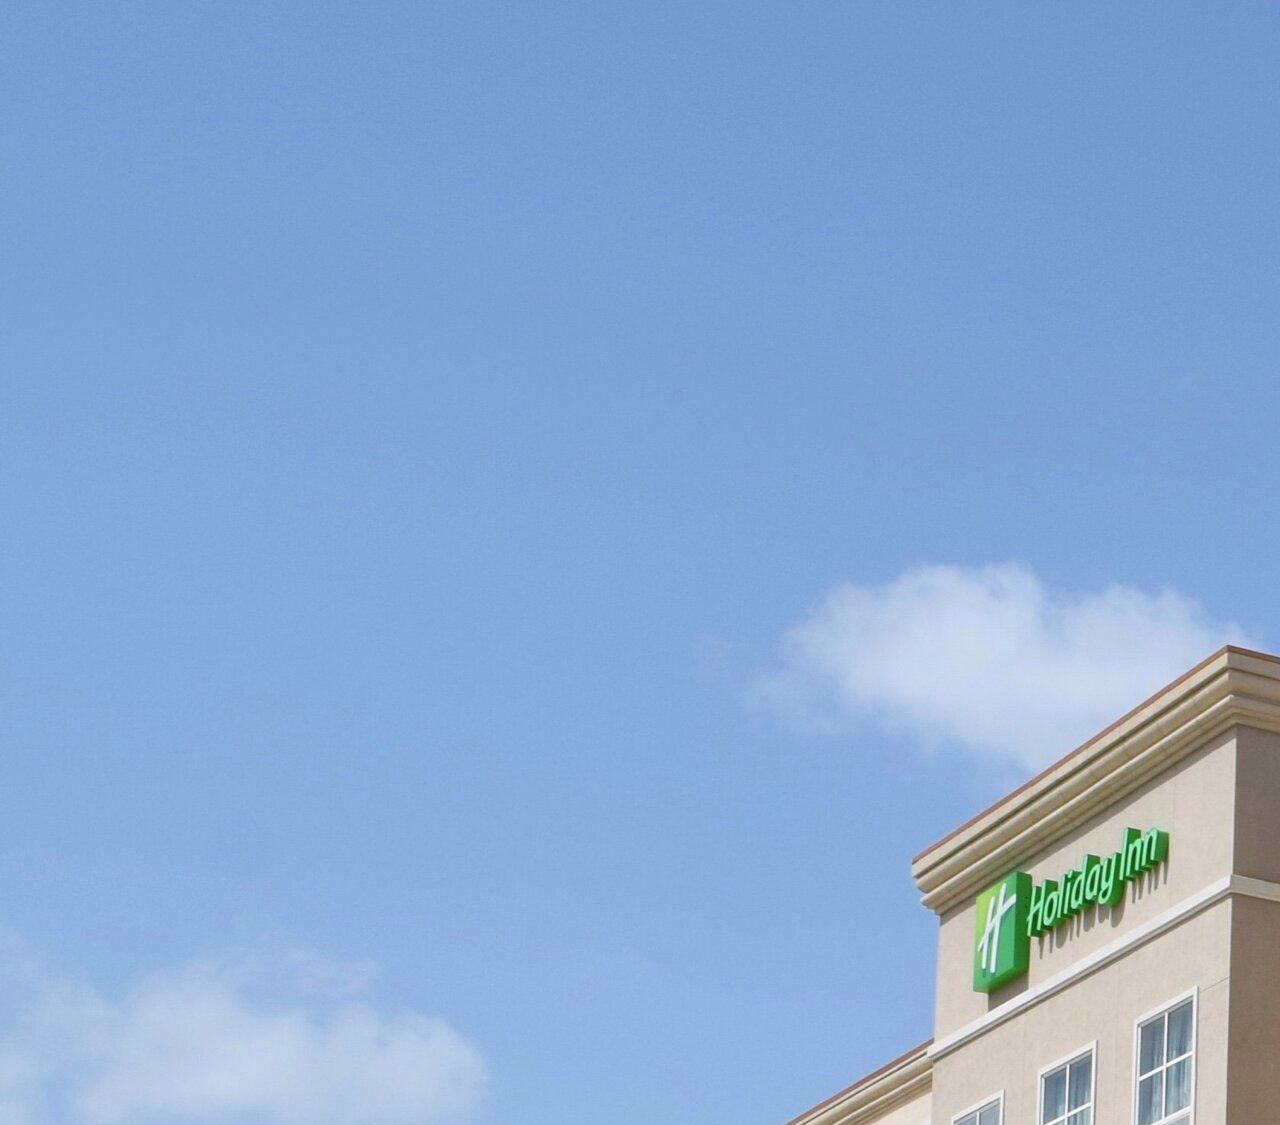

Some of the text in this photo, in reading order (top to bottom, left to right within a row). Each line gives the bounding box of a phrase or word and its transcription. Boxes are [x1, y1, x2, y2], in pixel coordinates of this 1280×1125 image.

[977, 882, 1017, 974] H
[1027, 827, 1169, 937] Holiday Inn
